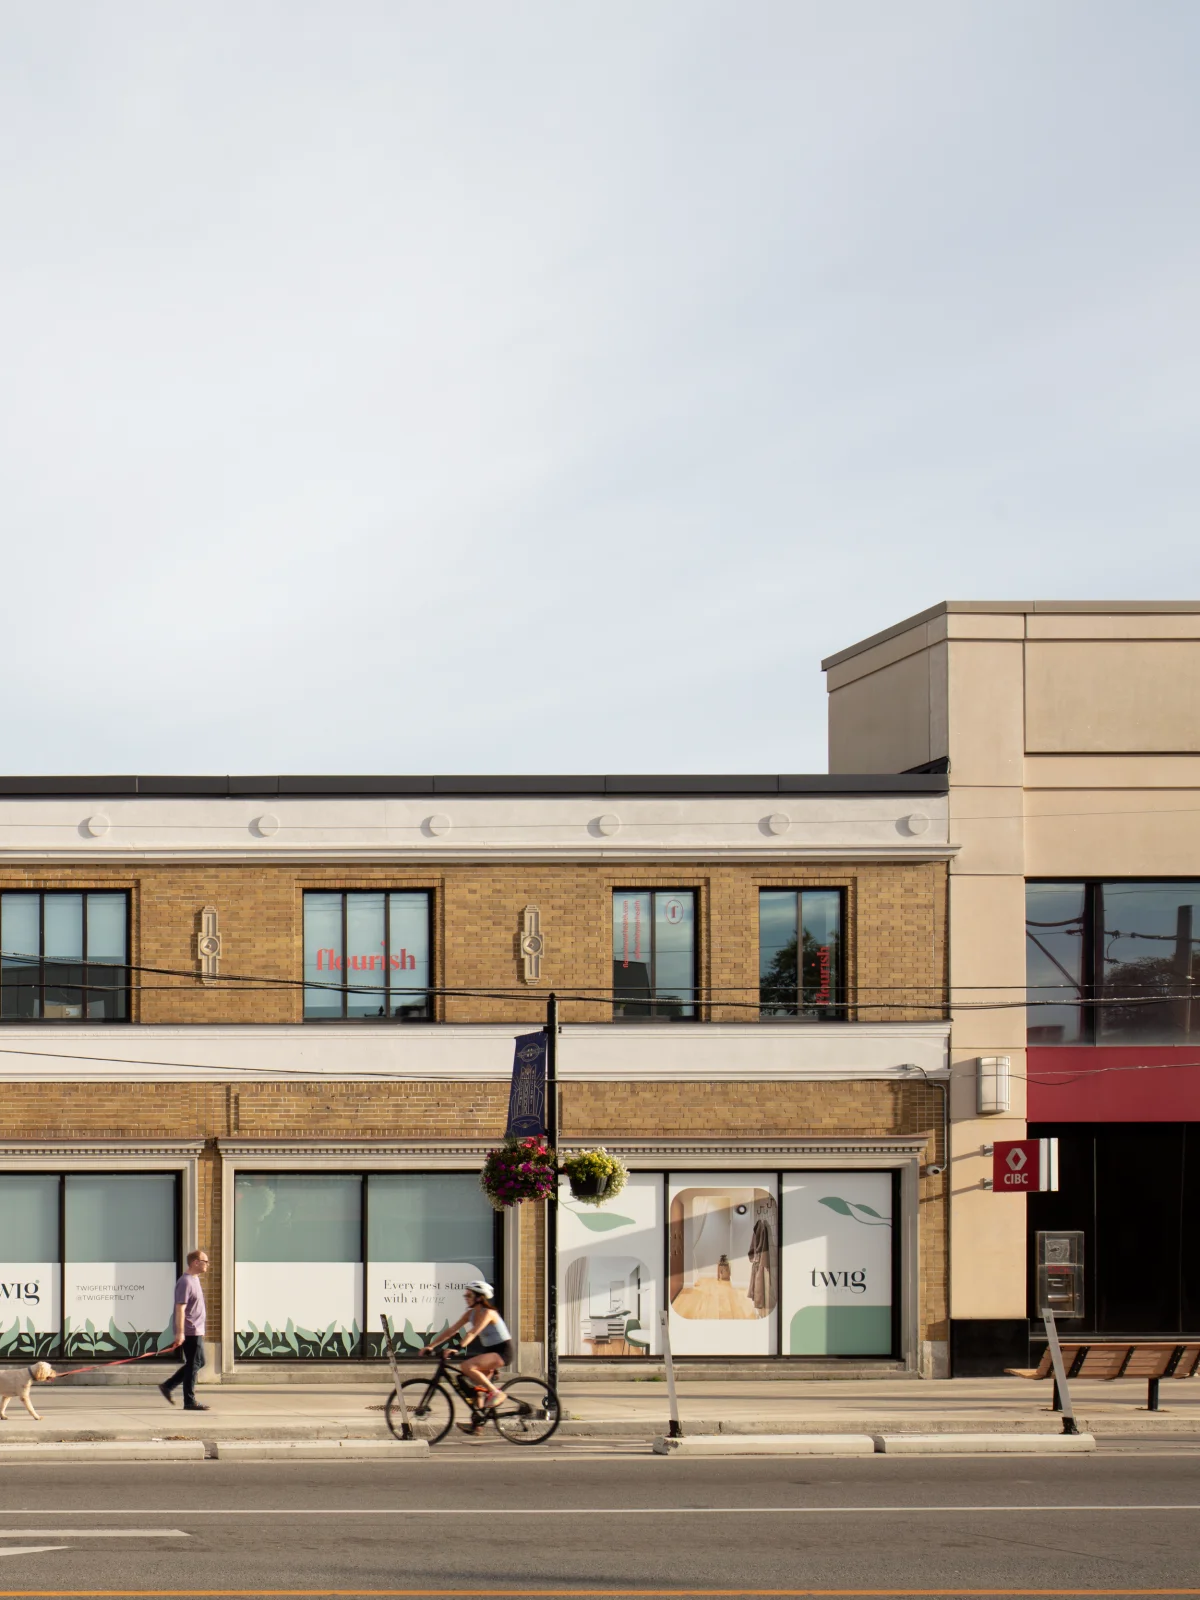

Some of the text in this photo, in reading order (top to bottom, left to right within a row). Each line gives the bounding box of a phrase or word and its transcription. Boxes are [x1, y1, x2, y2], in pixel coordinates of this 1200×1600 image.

[316, 940, 416, 971] flourish
[812, 946, 830, 1004] flourish
[1003, 1173, 1029, 1185] CIBC
[384, 1280, 469, 1292] Every nest star
[809, 1267, 867, 1294] twig
[384, 1294, 408, 1303] with
[421, 1293, 446, 1306] twig
